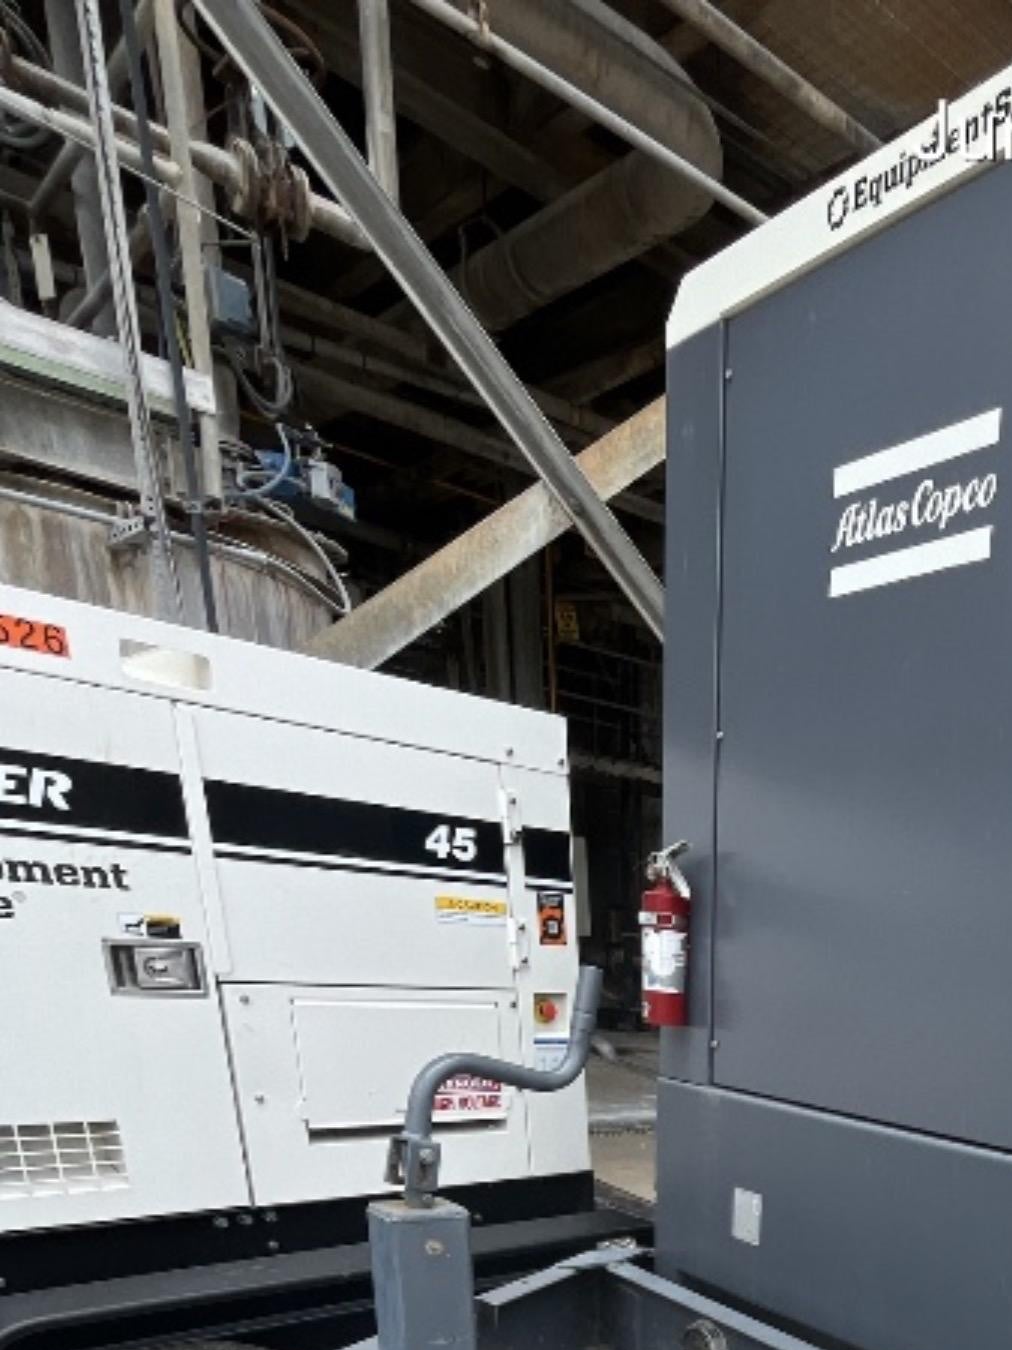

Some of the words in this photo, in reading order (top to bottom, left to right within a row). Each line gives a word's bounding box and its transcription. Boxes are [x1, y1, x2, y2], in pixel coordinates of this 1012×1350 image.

[830, 498, 911, 553] Atlas
[909, 472, 998, 531] Copco
[0, 764, 73, 811] ER
[425, 824, 478, 862] 45
[0, 858, 131, 891] ment
